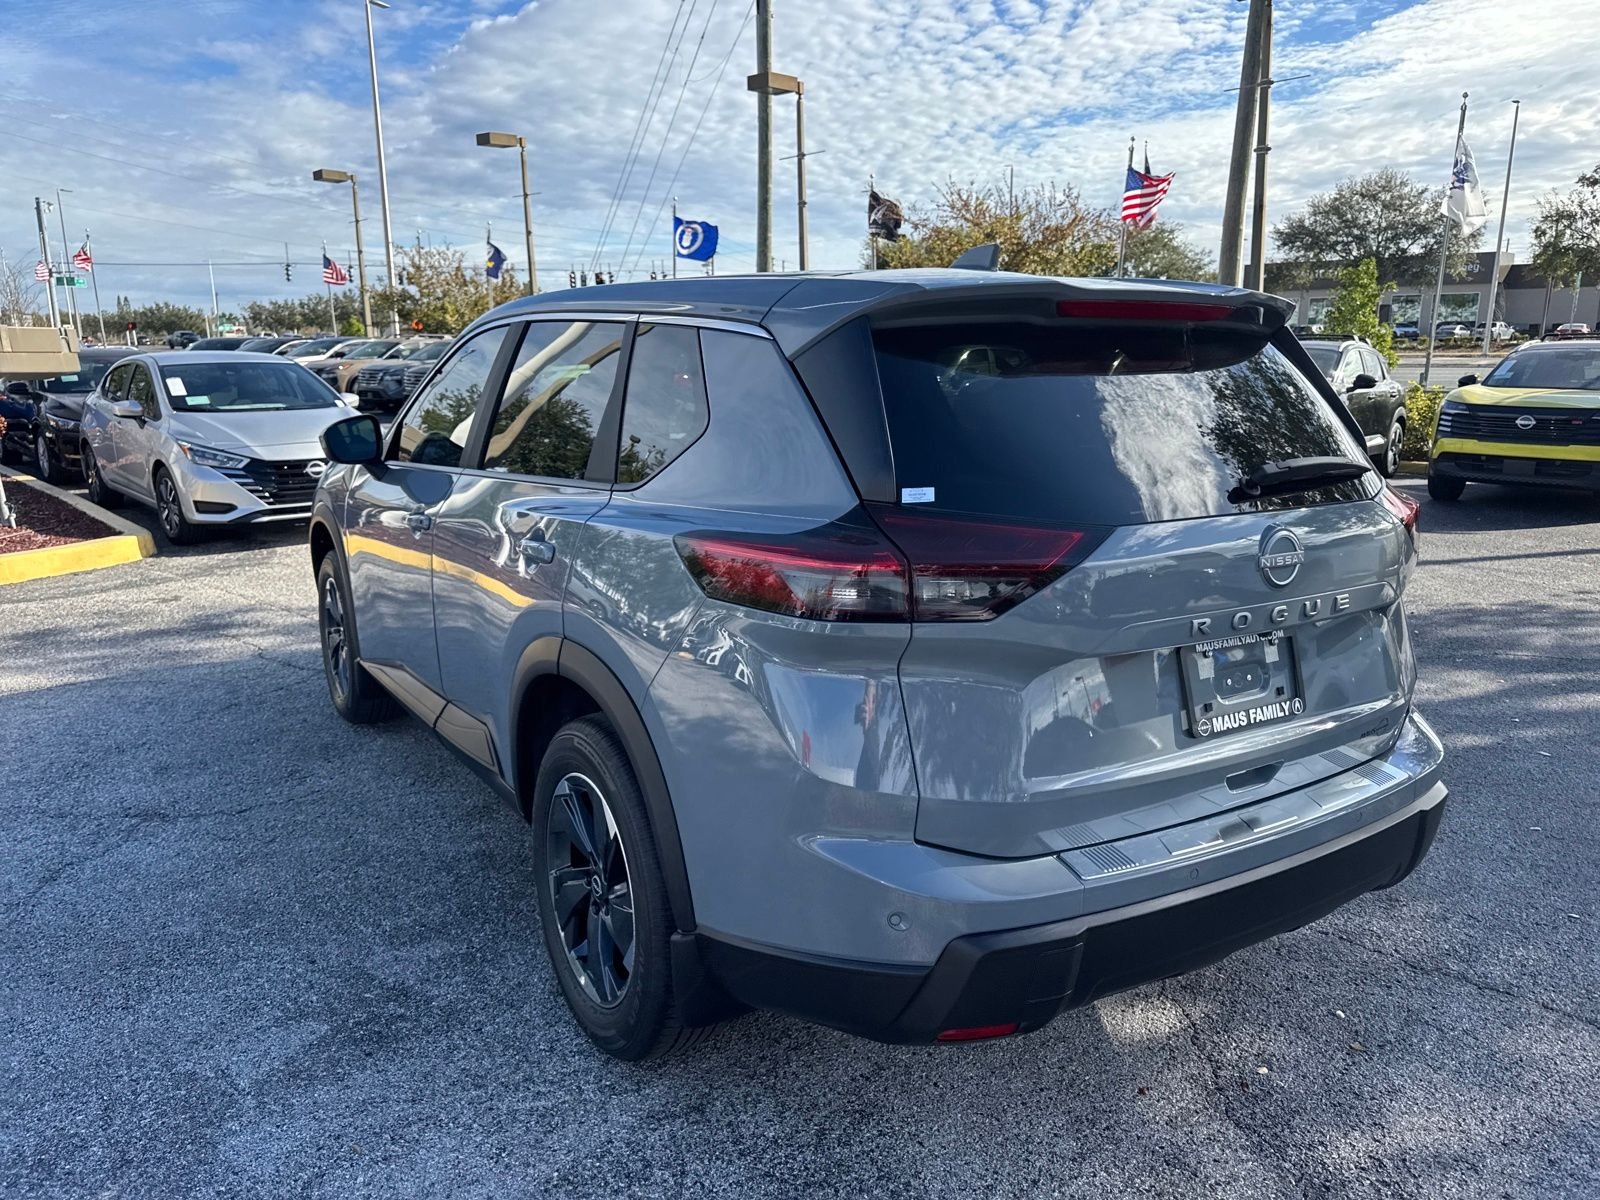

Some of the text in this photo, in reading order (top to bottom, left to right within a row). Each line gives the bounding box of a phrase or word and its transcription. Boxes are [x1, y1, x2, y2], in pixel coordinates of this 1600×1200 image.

[1261, 554, 1304, 567] NISSAN
[1190, 593, 1350, 638] ROGUE
[1212, 700, 1290, 733] MAUS FAMILY
